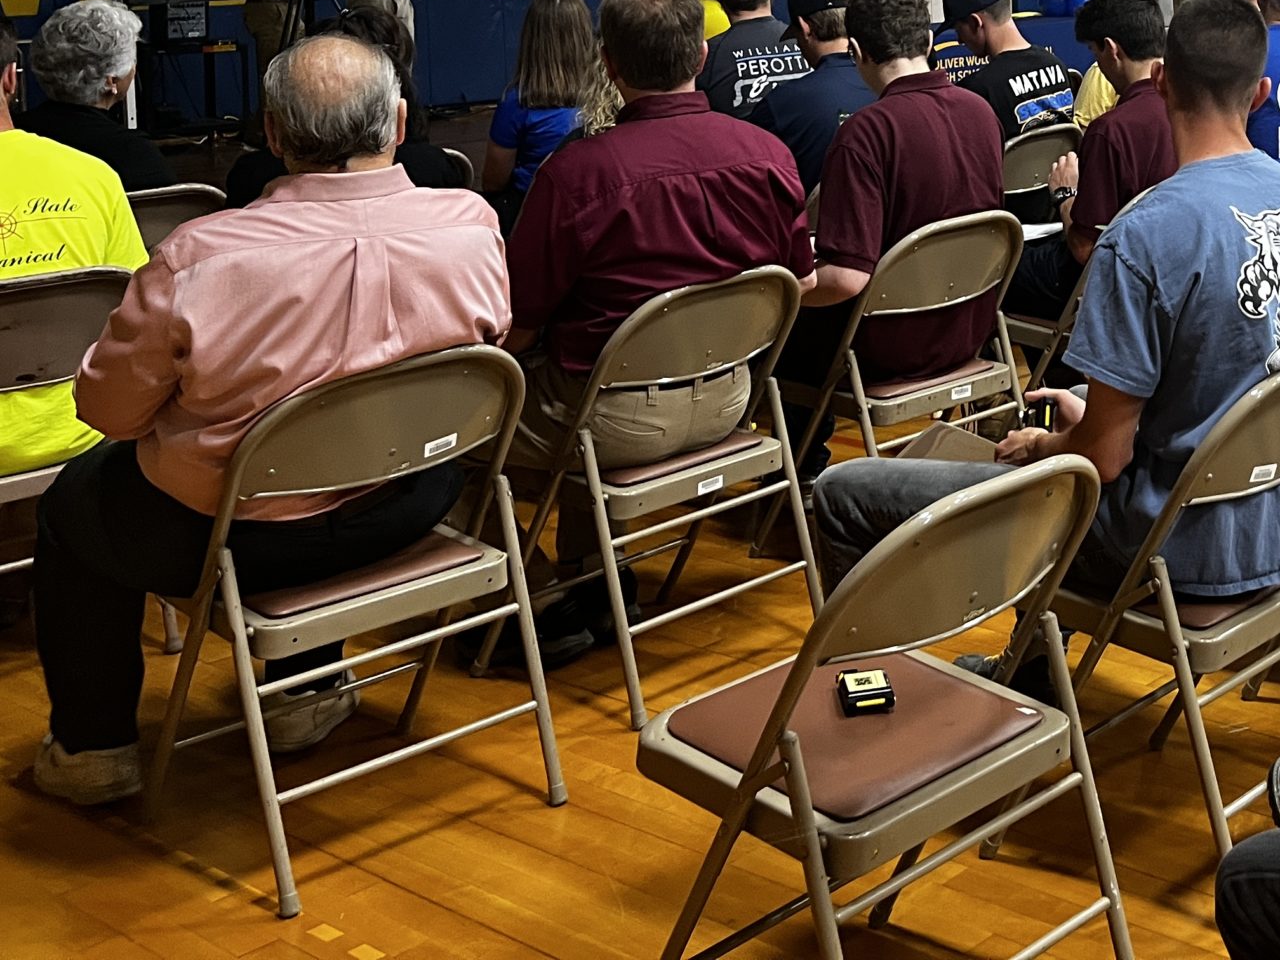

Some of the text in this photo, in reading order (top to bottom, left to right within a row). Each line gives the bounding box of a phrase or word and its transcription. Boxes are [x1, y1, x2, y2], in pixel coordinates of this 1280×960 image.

[736, 55, 809, 78] PEROTTI
[1008, 64, 1066, 97] MATAVA
[23, 196, 82, 216] State
